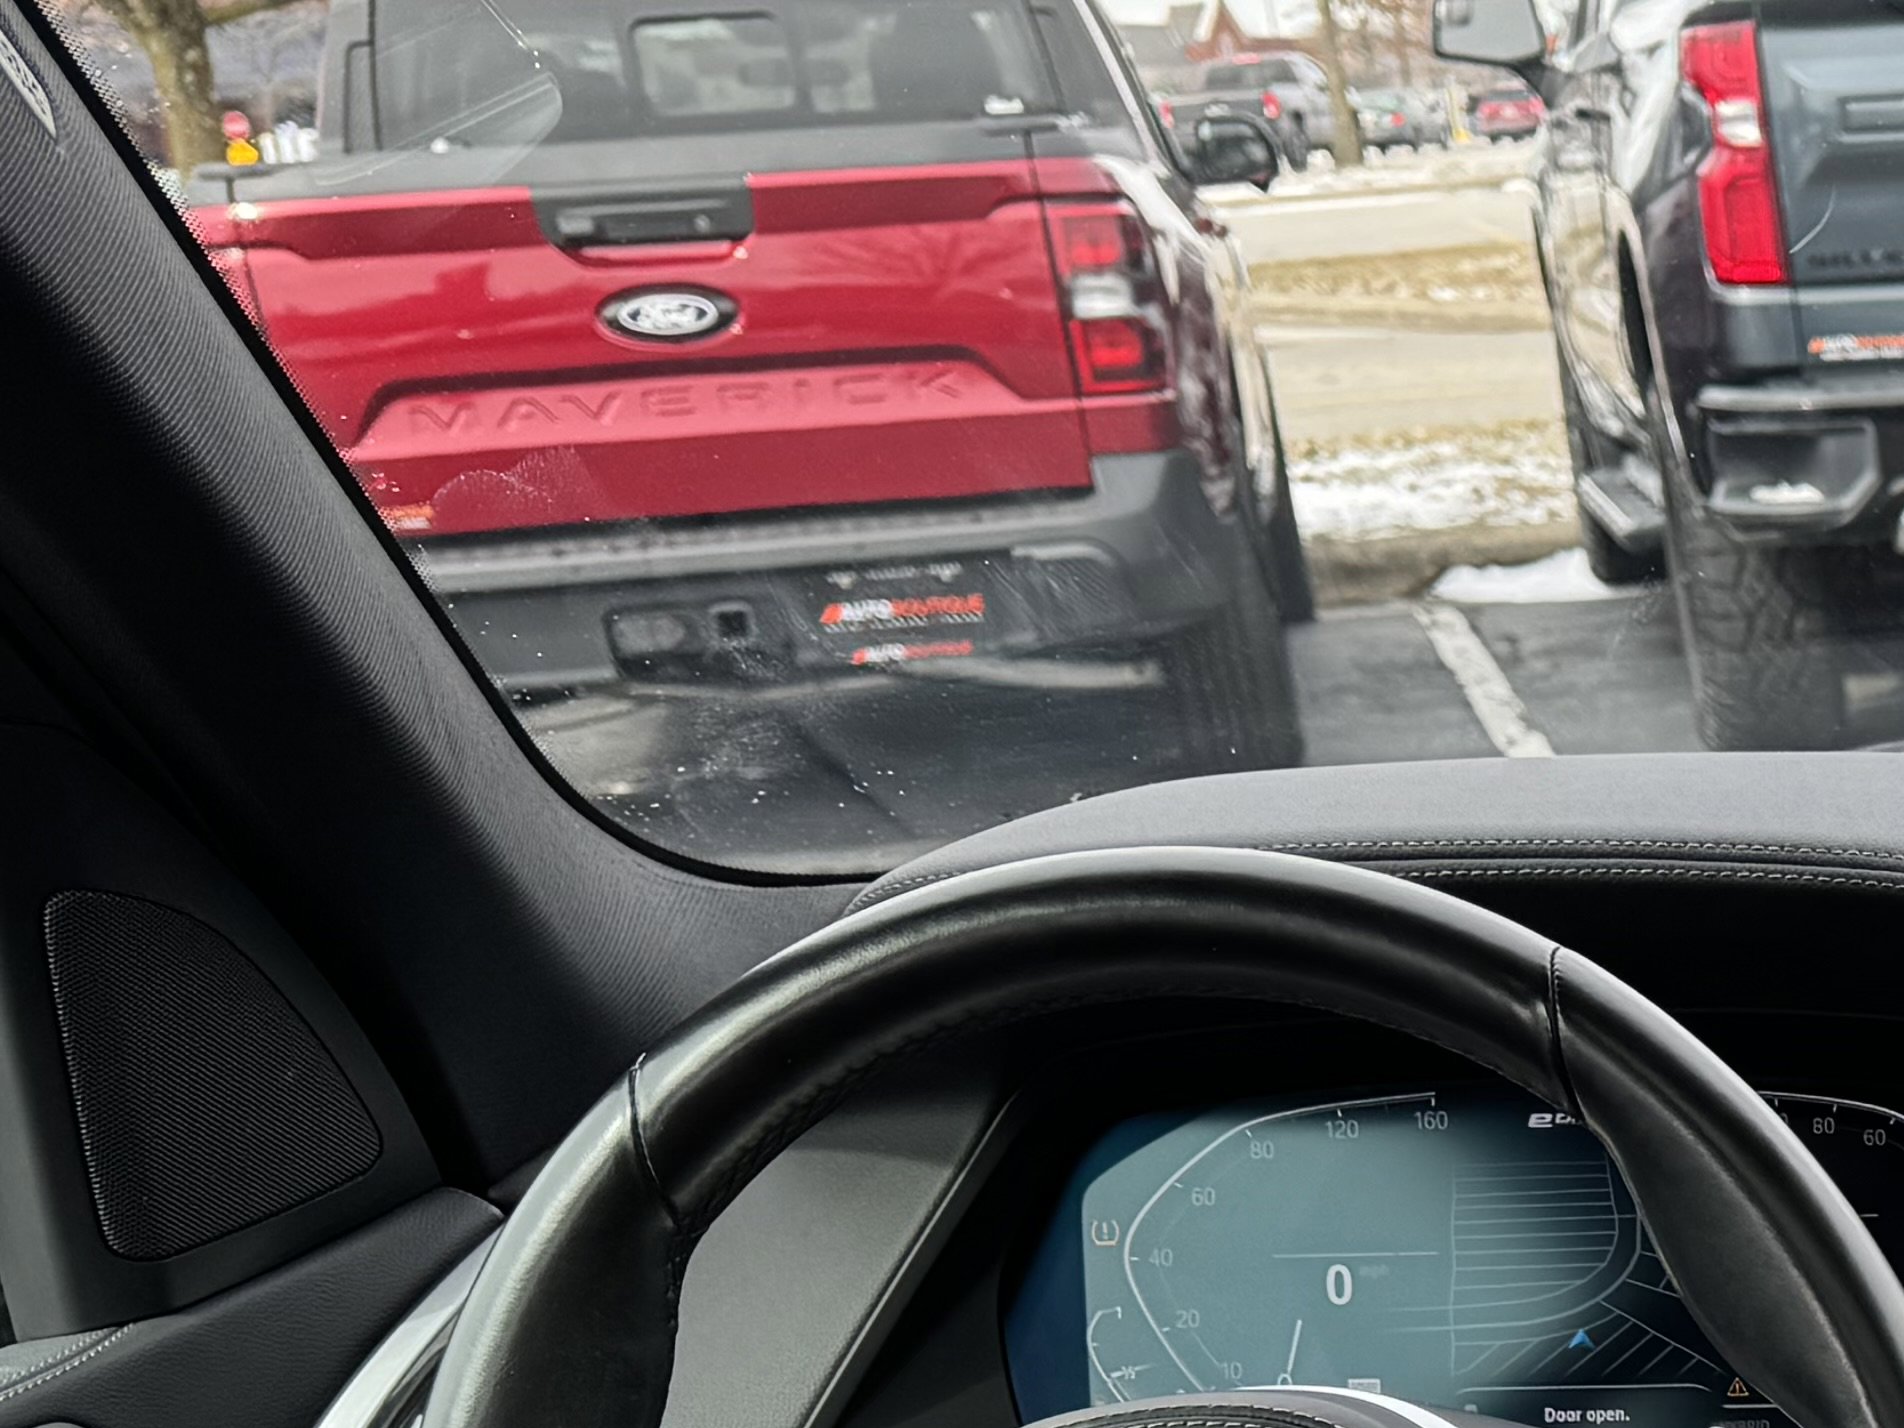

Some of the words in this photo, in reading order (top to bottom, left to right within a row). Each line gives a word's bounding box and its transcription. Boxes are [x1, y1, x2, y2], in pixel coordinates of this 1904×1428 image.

[406, 371, 965, 438] MAVERICK
[1325, 1119, 1361, 1140] 120
[1413, 1110, 1450, 1131] 160
[1811, 1116, 1836, 1135] 80
[1862, 1128, 1887, 1147] 60
[1249, 1140, 1275, 1160] 80
[1190, 1186, 1217, 1207] 60
[1147, 1248, 1174, 1269] 40
[1325, 1263, 1353, 1305] 0
[1174, 1309, 1201, 1329] 20
[1220, 1361, 1244, 1381] 10
[1543, 1407, 1582, 1424] Door
[1585, 1409, 1631, 1425] open.
